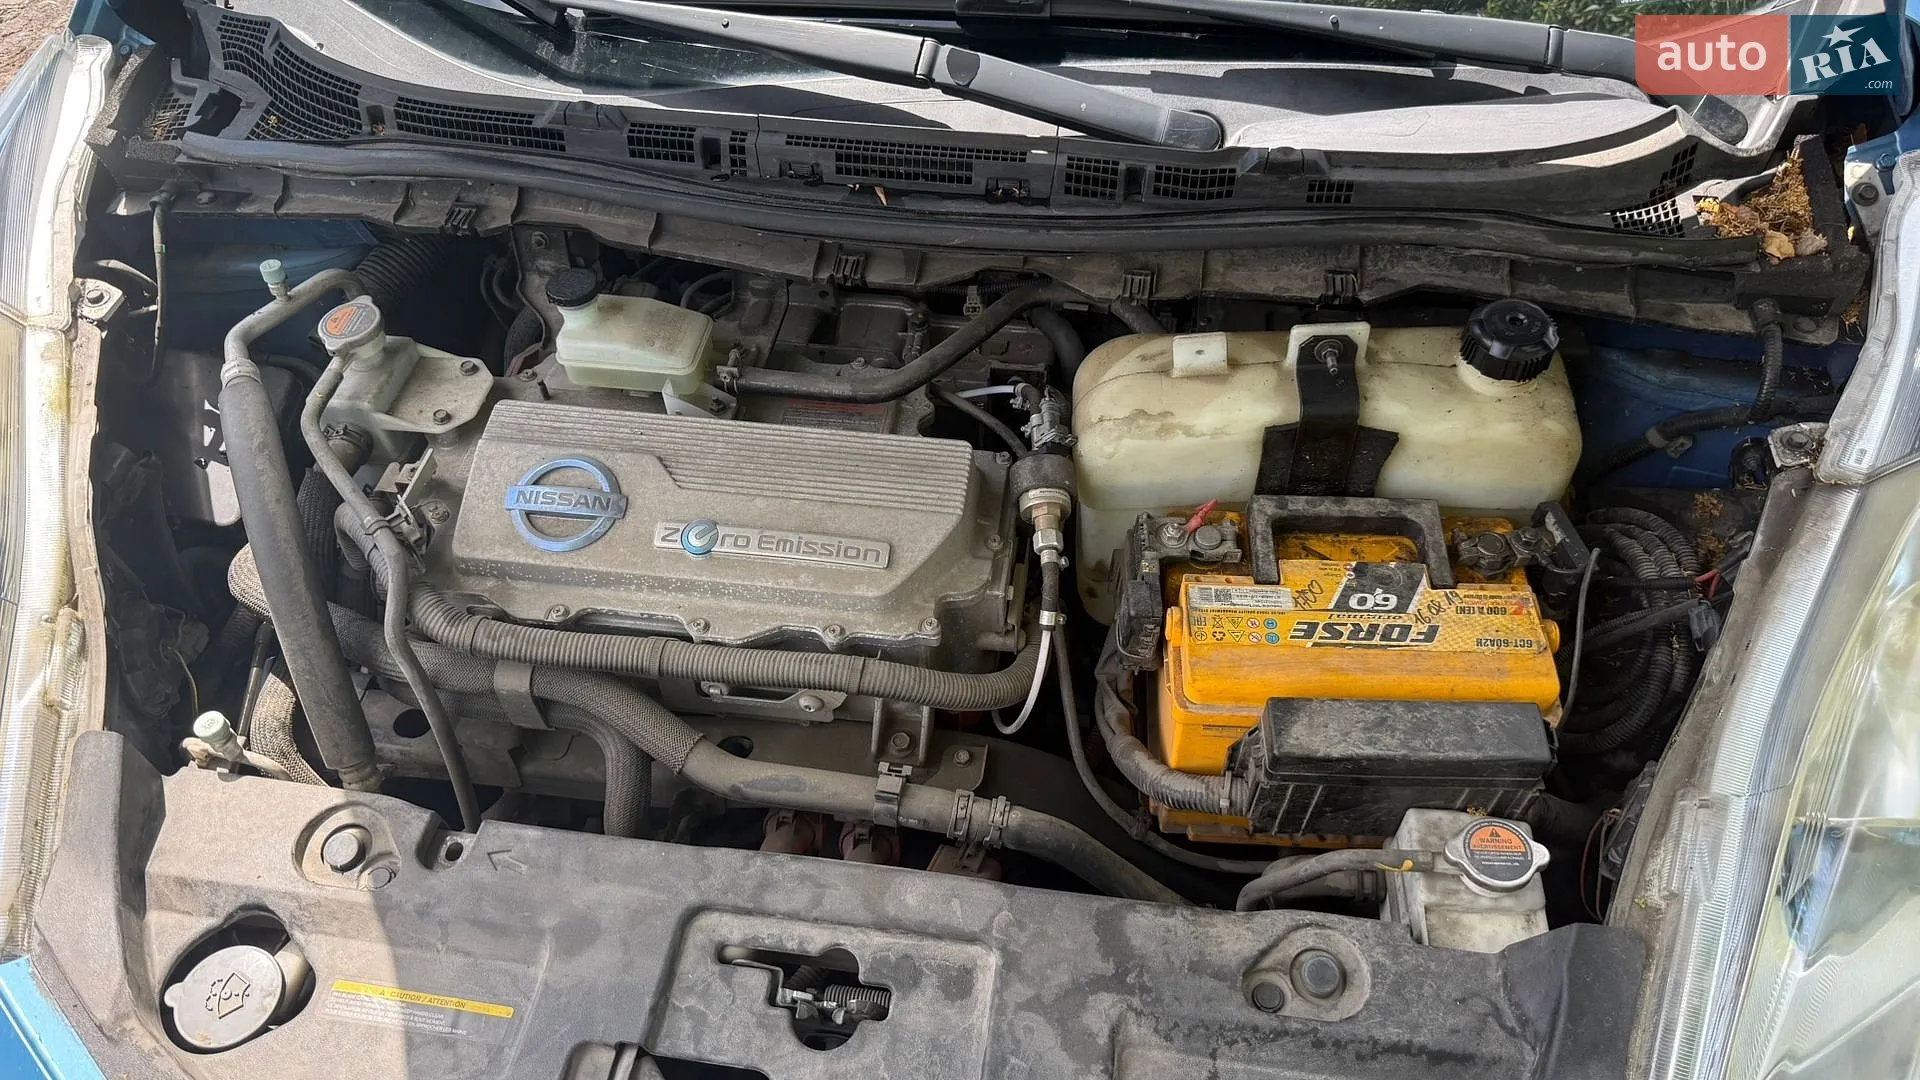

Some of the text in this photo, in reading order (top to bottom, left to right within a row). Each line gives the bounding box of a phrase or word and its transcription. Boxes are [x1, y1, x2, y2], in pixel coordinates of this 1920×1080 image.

[515, 488, 612, 511] NISSAN
[757, 534, 882, 563] Emission
[1328, 613, 1402, 621] original
[1487, 606, 1507, 616] 600
[1289, 621, 1440, 644] FORSE
[390, 991, 421, 1002] CAUTION
[428, 996, 466, 1009] ATTENTION
